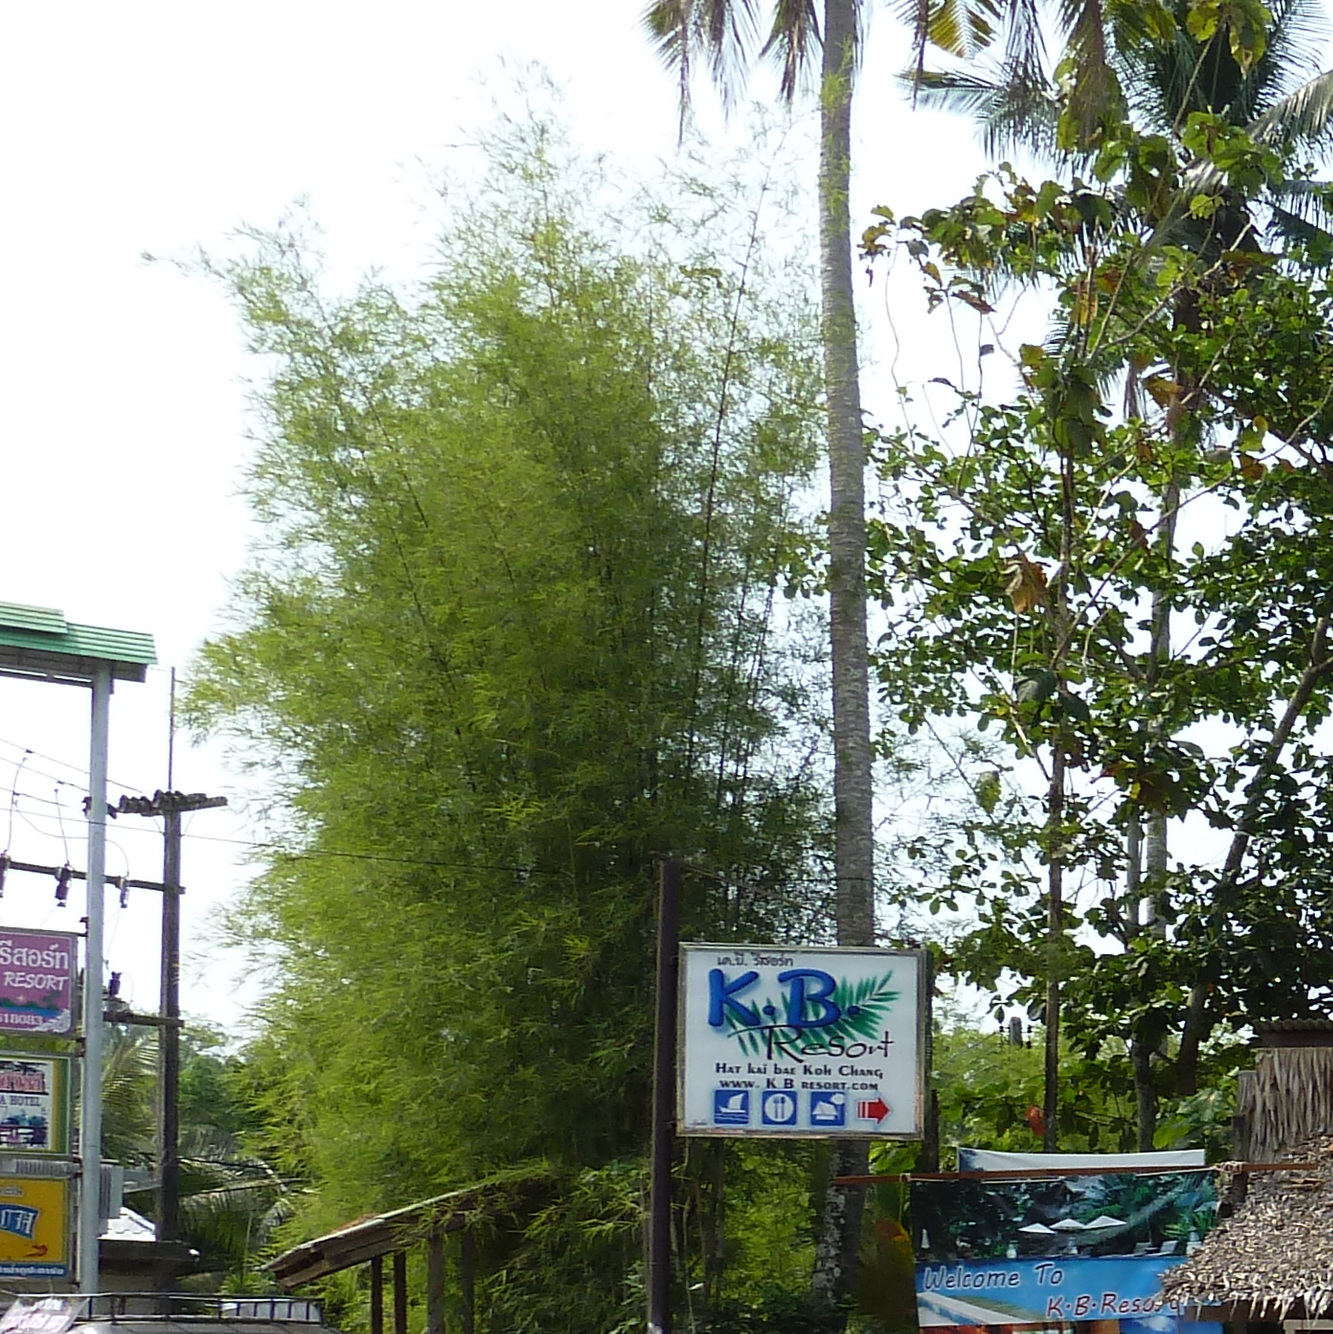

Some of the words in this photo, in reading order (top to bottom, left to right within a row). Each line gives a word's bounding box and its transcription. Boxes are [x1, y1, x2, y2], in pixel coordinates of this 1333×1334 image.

[4, 971, 69, 991] RESORT
[708, 968, 861, 1029] K.B.
[728, 1024, 895, 1063] Resort
[924, 1266, 1020, 1291] Welcome
[1034, 1262, 1064, 1286] To
